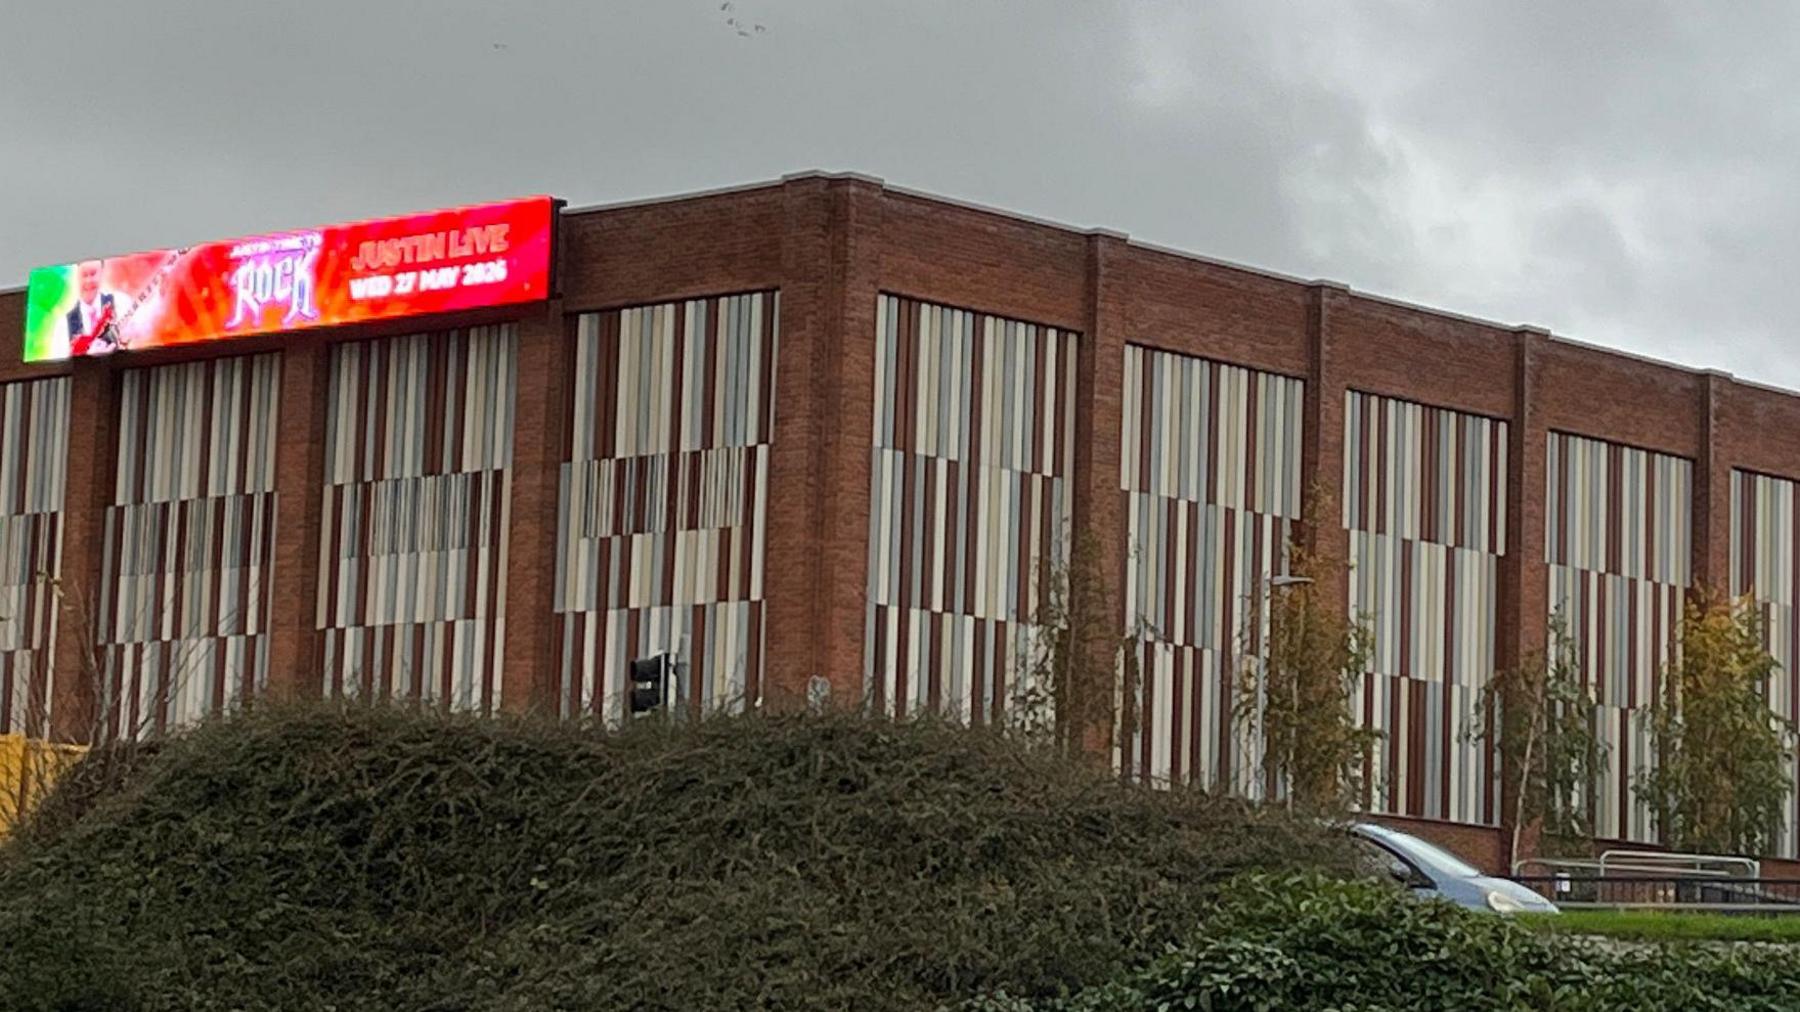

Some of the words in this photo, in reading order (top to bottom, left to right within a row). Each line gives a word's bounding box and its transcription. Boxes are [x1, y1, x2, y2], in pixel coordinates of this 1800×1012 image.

[350, 231, 446, 271] JUSTIN
[448, 223, 510, 258] LIVE
[225, 248, 320, 329] ROCK
[349, 275, 392, 300] WED
[394, 270, 417, 294] 27
[419, 265, 460, 292] MAY
[462, 257, 508, 286] 2026
